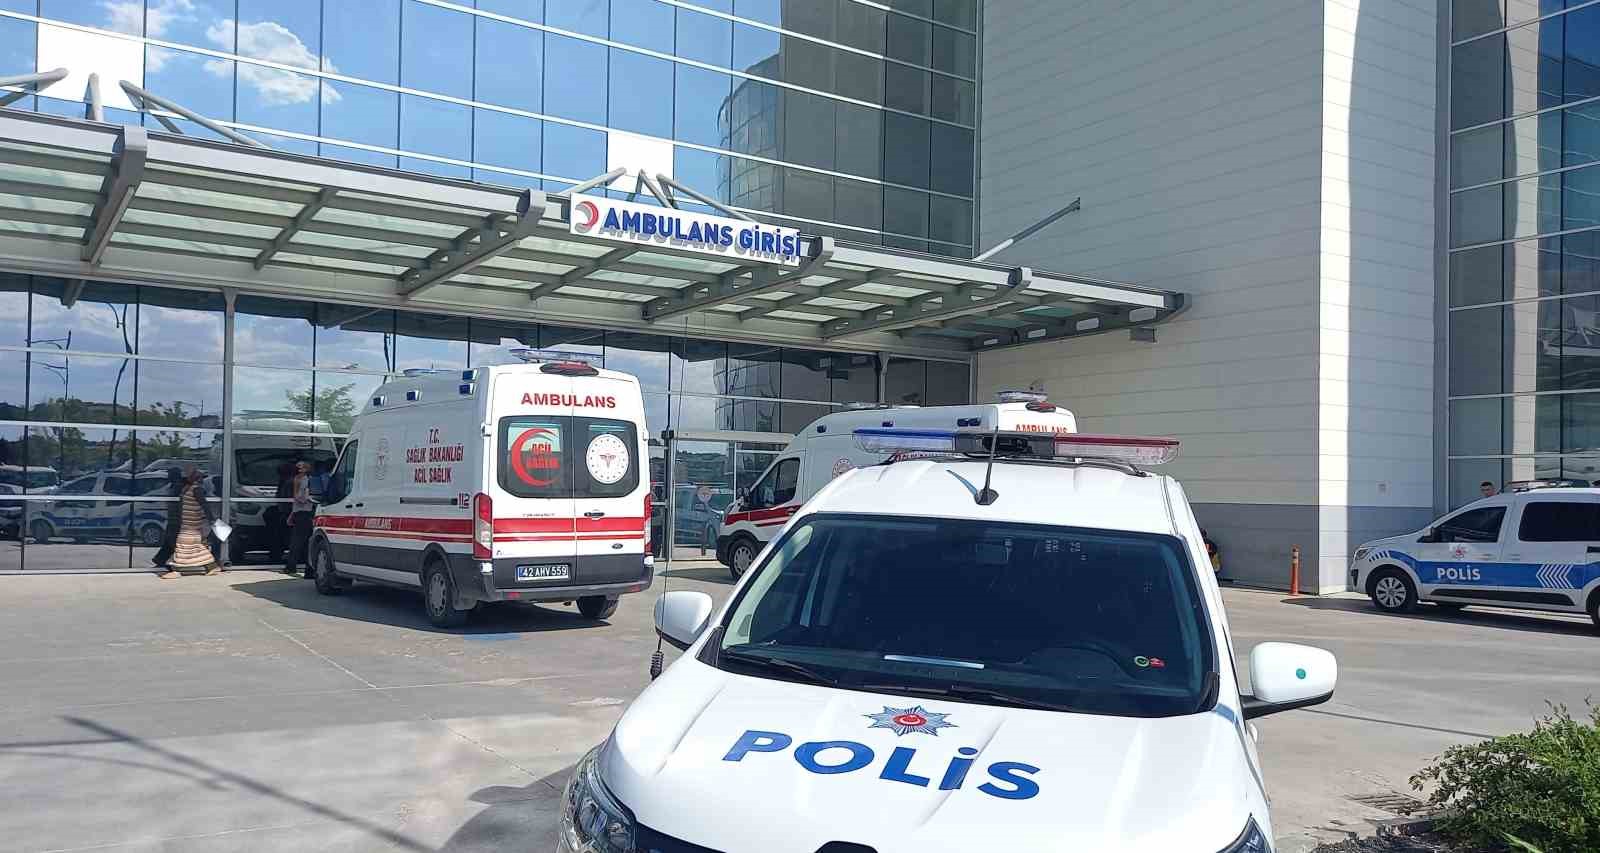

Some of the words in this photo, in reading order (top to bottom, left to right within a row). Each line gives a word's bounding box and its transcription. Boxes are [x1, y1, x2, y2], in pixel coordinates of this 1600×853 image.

[603, 207, 734, 247] AMBULANS
[521, 392, 616, 408] AMBULANS
[429, 428, 440, 444] T.C.
[406, 445, 427, 463] SAĞLIK
[429, 443, 464, 462] BAKANLIĞI
[429, 464, 452, 483] SAĞLIK
[458, 493, 471, 509] 112
[522, 567, 534, 577] 42
[551, 566, 567, 576] 559
[1437, 565, 1481, 580] POLİS
[722, 730, 1041, 800] POLİS
